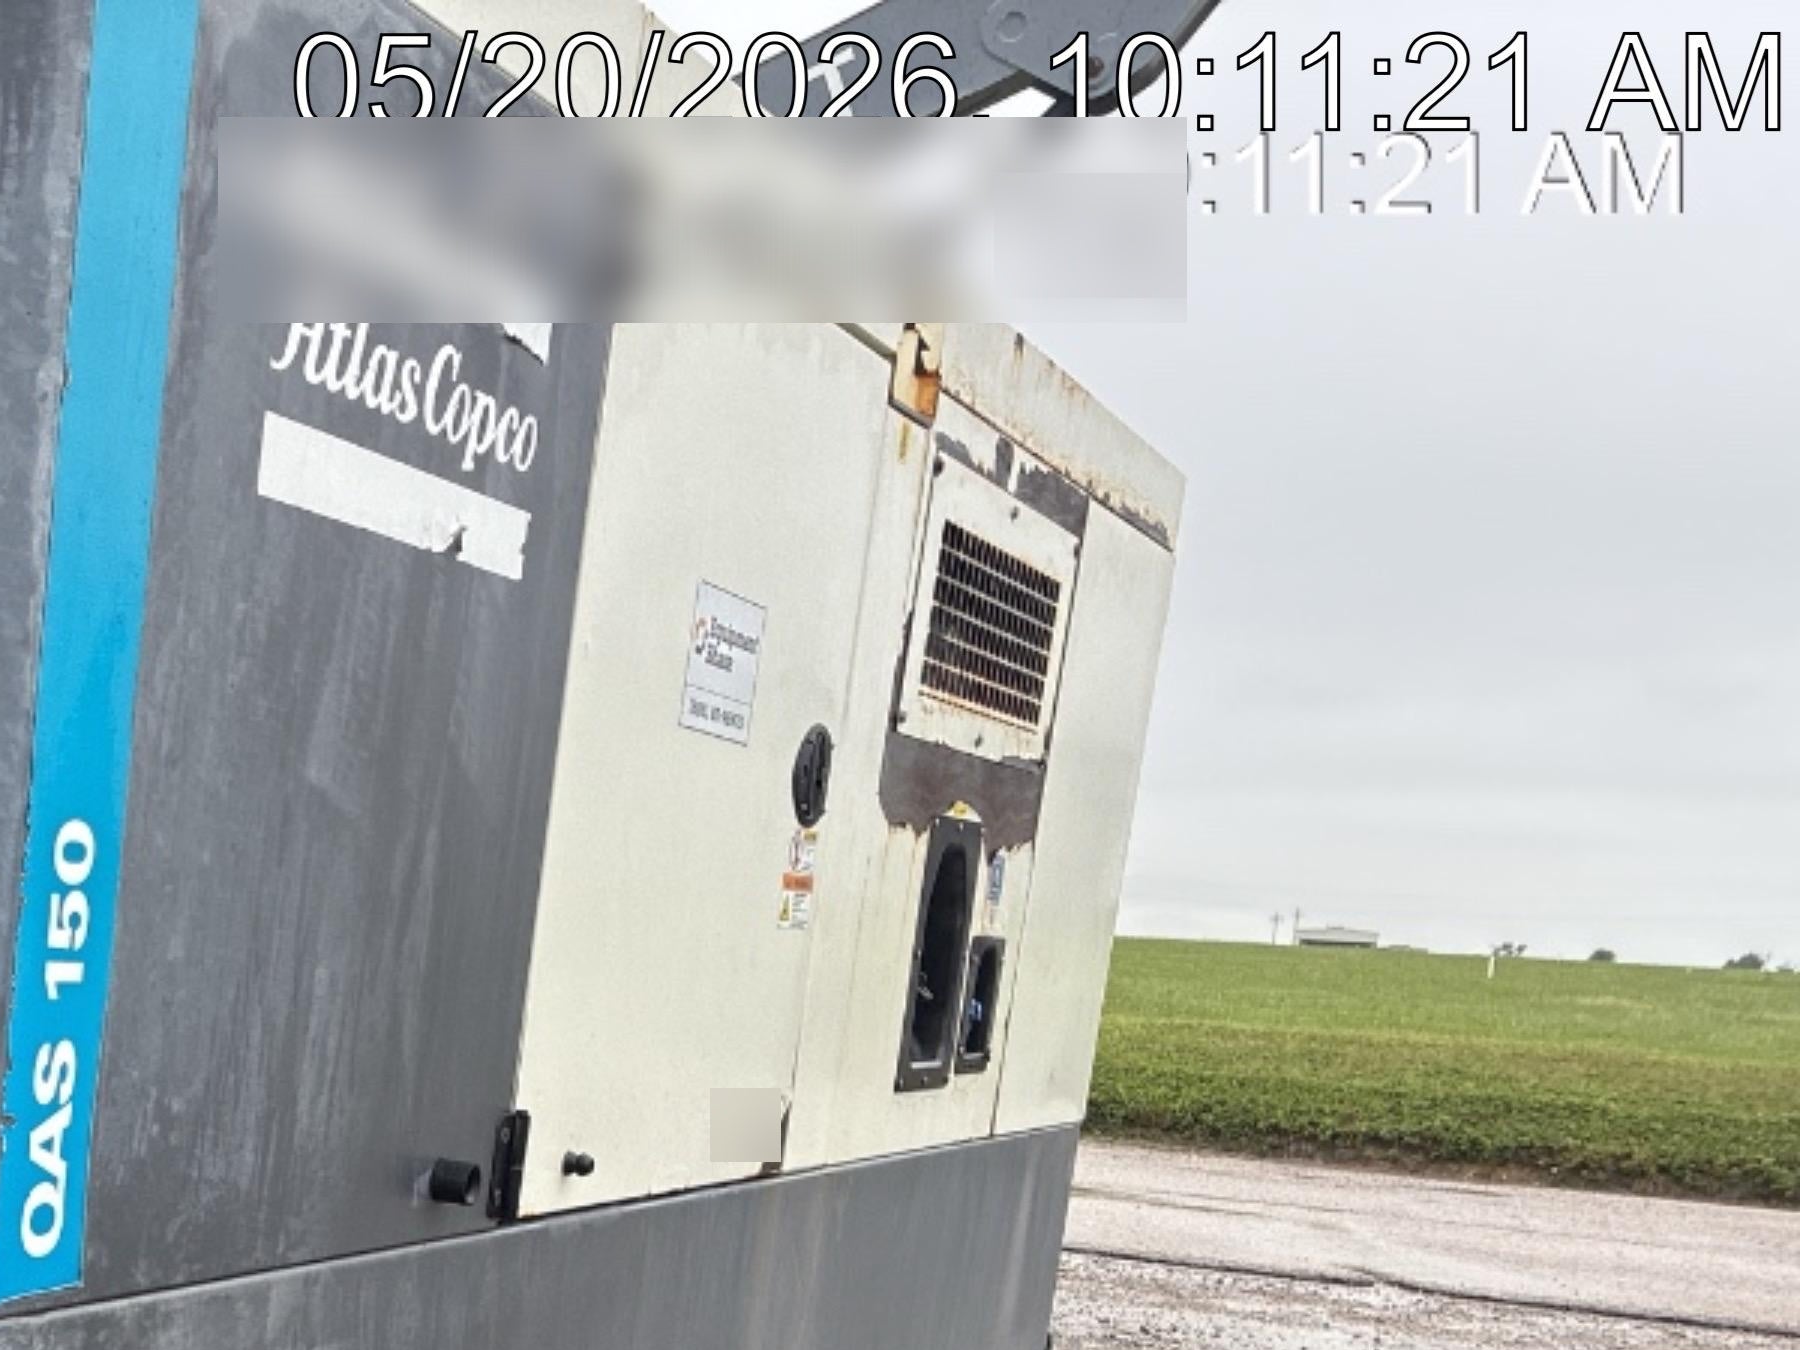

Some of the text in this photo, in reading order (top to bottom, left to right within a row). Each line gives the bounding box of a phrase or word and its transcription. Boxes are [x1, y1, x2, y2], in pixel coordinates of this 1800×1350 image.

[269, 322, 538, 472] Atlas Copco
[20, 817, 97, 1258] QAS 150
